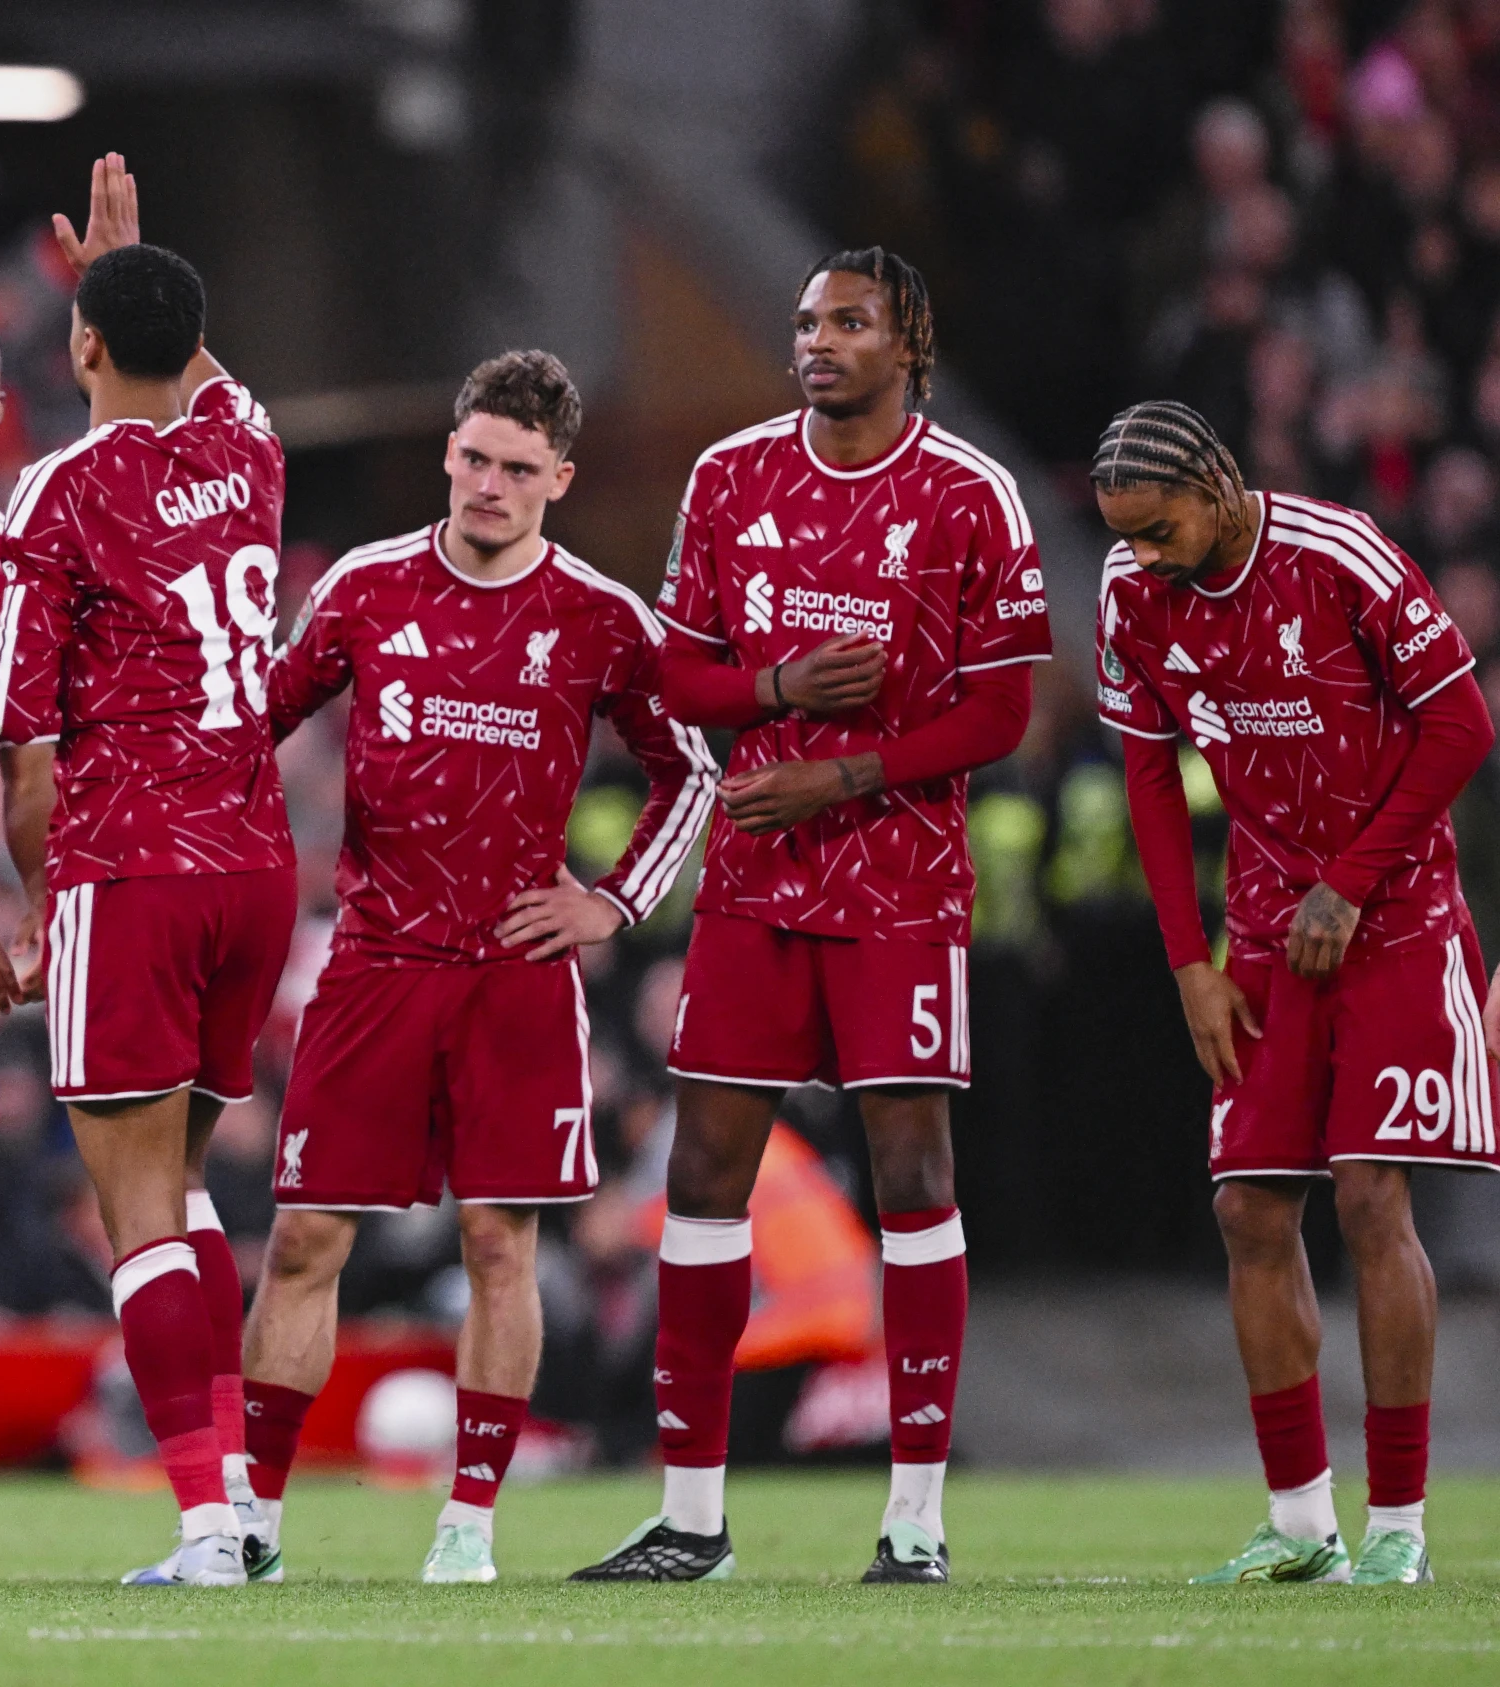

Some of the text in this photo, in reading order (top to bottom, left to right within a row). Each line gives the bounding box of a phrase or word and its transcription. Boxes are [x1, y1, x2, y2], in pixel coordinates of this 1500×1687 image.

[156, 473, 250, 528] GAKPO
[783, 586, 891, 621] standard
[996, 598, 1048, 621] Expe
[781, 606, 894, 642] chartered
[422, 694, 539, 729] standard
[1224, 696, 1313, 719] standard
[1233, 713, 1325, 737] chartered
[420, 715, 542, 751] chartered
[910, 984, 942, 1060] 5
[1374, 1065, 1452, 1142] 29
[552, 1108, 584, 1183] 7
[902, 1355, 950, 1375] LFC
[464, 1417, 508, 1438] LFC
